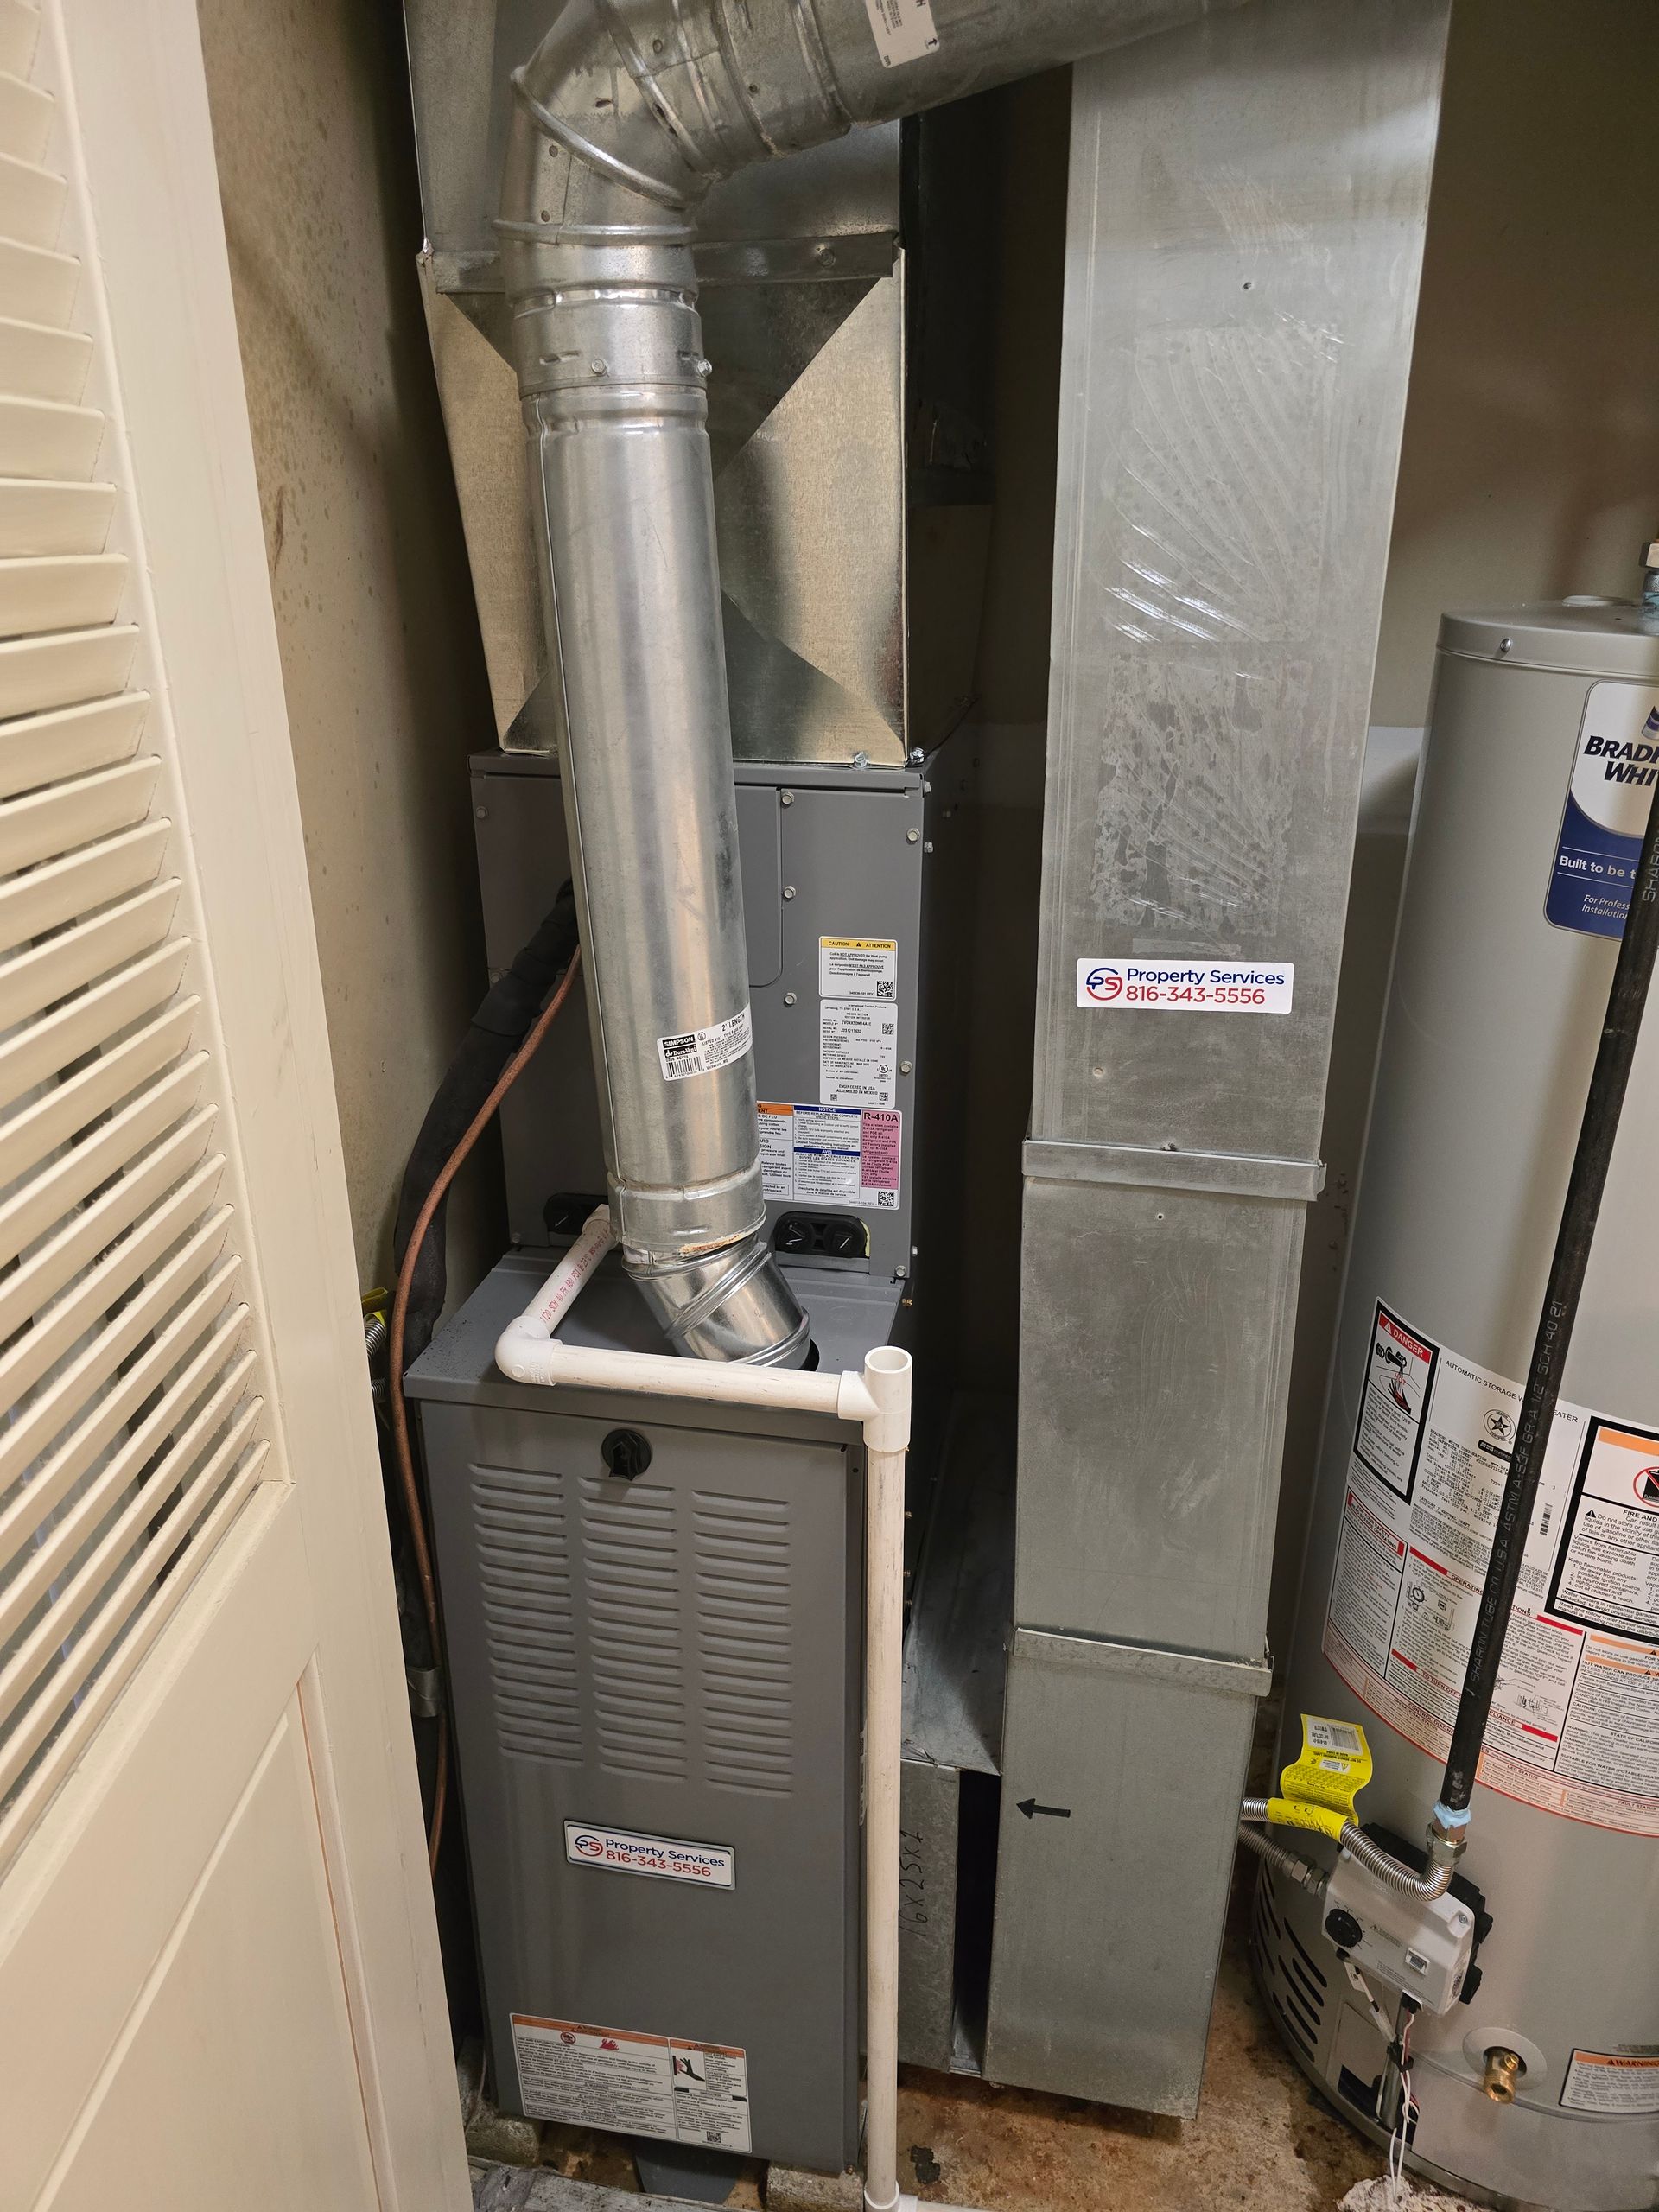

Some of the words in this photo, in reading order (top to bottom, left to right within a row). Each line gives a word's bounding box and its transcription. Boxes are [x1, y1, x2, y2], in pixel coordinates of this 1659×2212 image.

[1604, 761, 1657, 786] WHI
[1560, 855, 1586, 870] Built
[1591, 862, 1603, 873] to
[1607, 865, 1624, 877] be
[1599, 898, 1630, 910] Profess
[1127, 968, 1205, 985] Property
[1210, 969, 1285, 985] Services
[1126, 985, 1265, 1005] 816-343-5556
[728, 1013, 744, 1028] LENGTH
[664, 1037, 693, 1046] SIMPSON
[864, 1113, 898, 1122] R-410A
[1393, 1329, 1423, 1357] DANGER
[1445, 1360, 1482, 1383] AUTOMATIC
[1483, 1380, 1516, 1399] STORAGE
[1554, 1410, 1578, 1422] EATER
[1471, 1632, 1488, 1681] SHARON
[1481, 1597, 1497, 1629] TUBE
[1503, 1492, 1520, 1531] ASTM
[1537, 1344, 1553, 1376] SCH
[1545, 1320, 1558, 1340] 40
[1623, 1510, 1640, 1518] FIRE
[1585, 1516, 1603, 1525] liquids
[1622, 1526, 1642, 1536] vicinity
[1602, 1528, 1626, 1538] gasoline
[1636, 1535, 1650, 1544] other
[1620, 1537, 1635, 1546] other
[1572, 1544, 1586, 1553] catch
[1597, 1552, 1618, 1562] causing
[1573, 1540, 1590, 1548] liquids
[1602, 1548, 1624, 1559] explode
[1574, 1535, 1593, 1544] Vapors
[1608, 1543, 1637, 1556] flammable
[1578, 1551, 1595, 1560] severe
[1568, 1557, 1582, 1566] Keep
[1584, 1562, 1611, 1573] flammable
[1612, 1572, 1638, 1581] products:
[1575, 1579, 1592, 1587] tightly
[1592, 1585, 1611, 1593] closed
[1578, 1571, 1600, 1580] possible
[1601, 1577, 1621, 1586] ignition
[1583, 1576, 1608, 1587] approved
[1591, 1588, 1617, 1599] children's
[1579, 1594, 1599, 1605] heaters
[1607, 1603, 1635, 1614] residential
[1636, 1611, 1658, 1620] garages
[1611, 1610, 1633, 1621] physical
[1558, 1606, 1578, 1616] manual
[1585, 1614, 1605, 1624] missing
[1606, 1621, 1626, 1630] contact
[1586, 1609, 1601, 1618] follow
[1618, 1619, 1636, 1628] heater
[1422, 1671, 1430, 1680] TO
[1431, 1676, 1445, 1689] TURN
[1408, 1702, 1431, 1721] CONTROL
[1561, 1753, 1585, 1763] SUITABLE
[1519, 1769, 1538, 1780] STATUS
[606, 1839, 664, 1858] Property
[668, 1851, 725, 1867] Services
[606, 1850, 711, 1877] 816-343-5556
